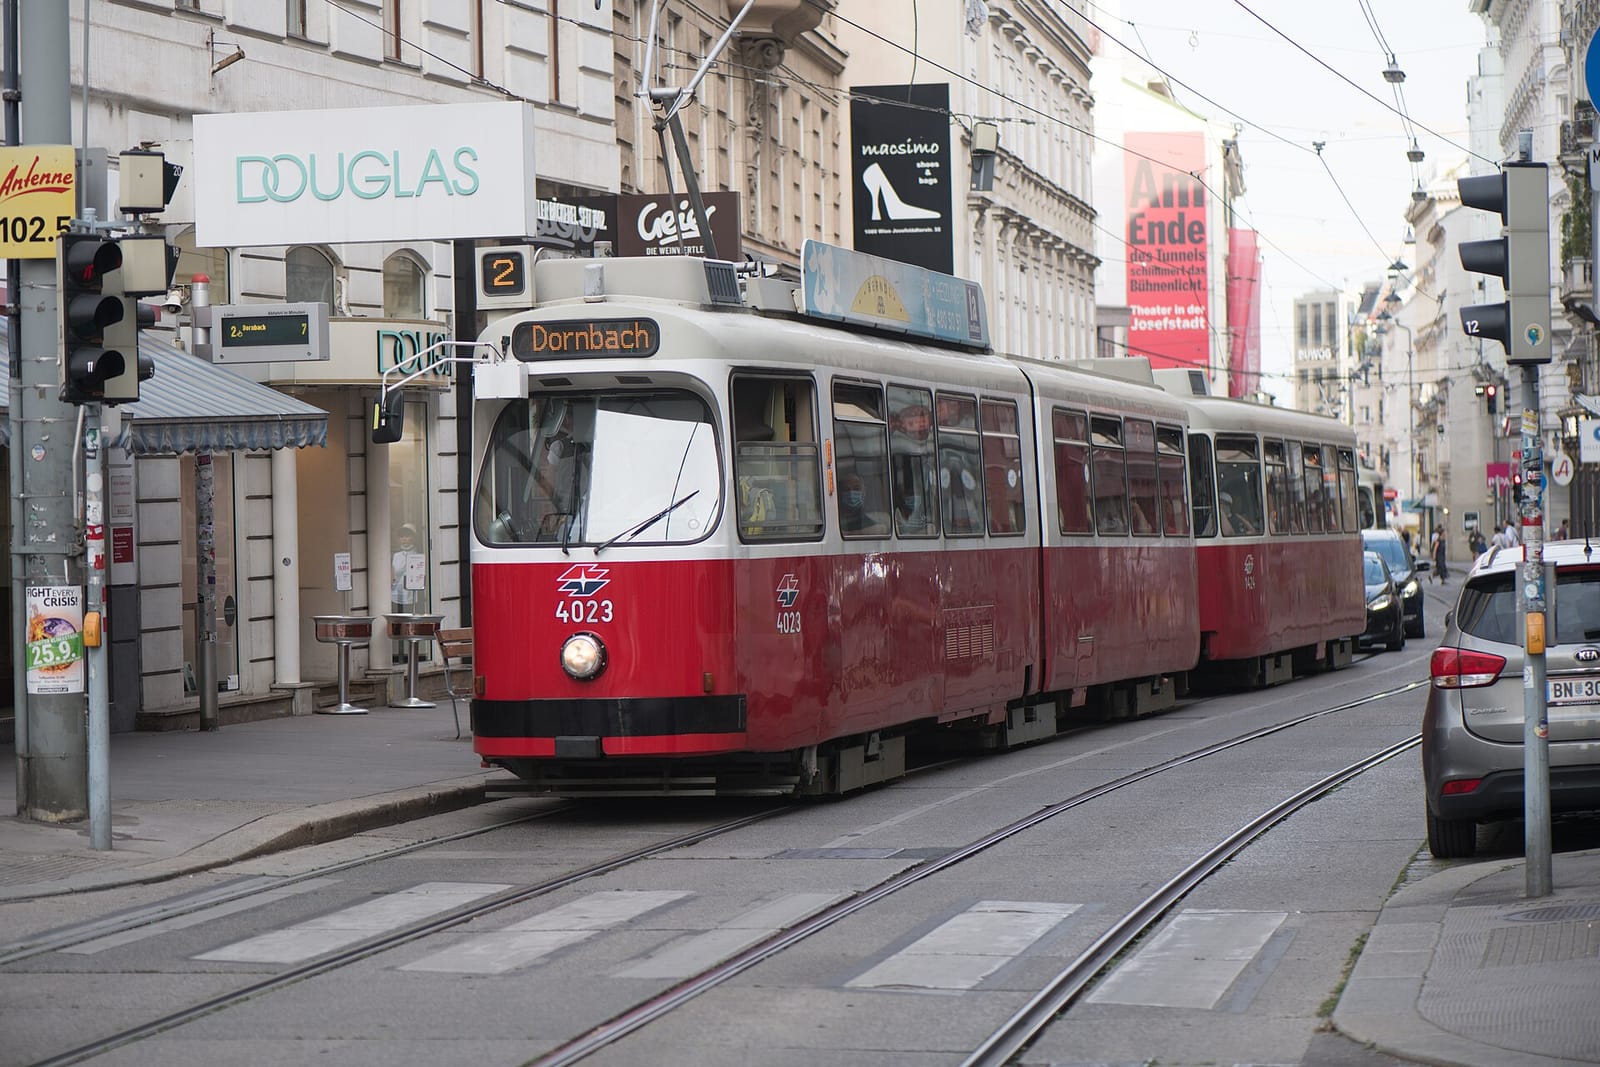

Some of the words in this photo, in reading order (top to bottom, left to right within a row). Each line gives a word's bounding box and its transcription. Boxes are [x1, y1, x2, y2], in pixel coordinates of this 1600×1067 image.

[916, 161, 940, 169] shoes
[0, 155, 74, 197] Antenne
[236, 147, 480, 203] DOUGLAS
[918, 177, 938, 186] bags
[1130, 159, 1205, 208] Am
[1129, 212, 1206, 246] Ende
[646, 247, 657, 255] DIE
[1130, 249, 1153, 262] des
[1157, 248, 1206, 262] Tunnels
[492, 258, 515, 287] 2
[1130, 303, 1172, 316] Theater
[1174, 304, 1185, 315] in
[230, 325, 237, 338] 2
[301, 322, 307, 335] 7
[1130, 316, 1206, 331] Josefstadt
[1465, 320, 1480, 334] 12
[531, 321, 649, 352] Dornbach
[27, 587, 51, 598] FIGHT
[43, 597, 78, 607] CRISIS!
[555, 600, 614, 623] 4023
[776, 611, 801, 634] 4023
[31, 640, 76, 665] 25.9.
[1578, 650, 1599, 660] KIA
[1553, 682, 1573, 698] BN
